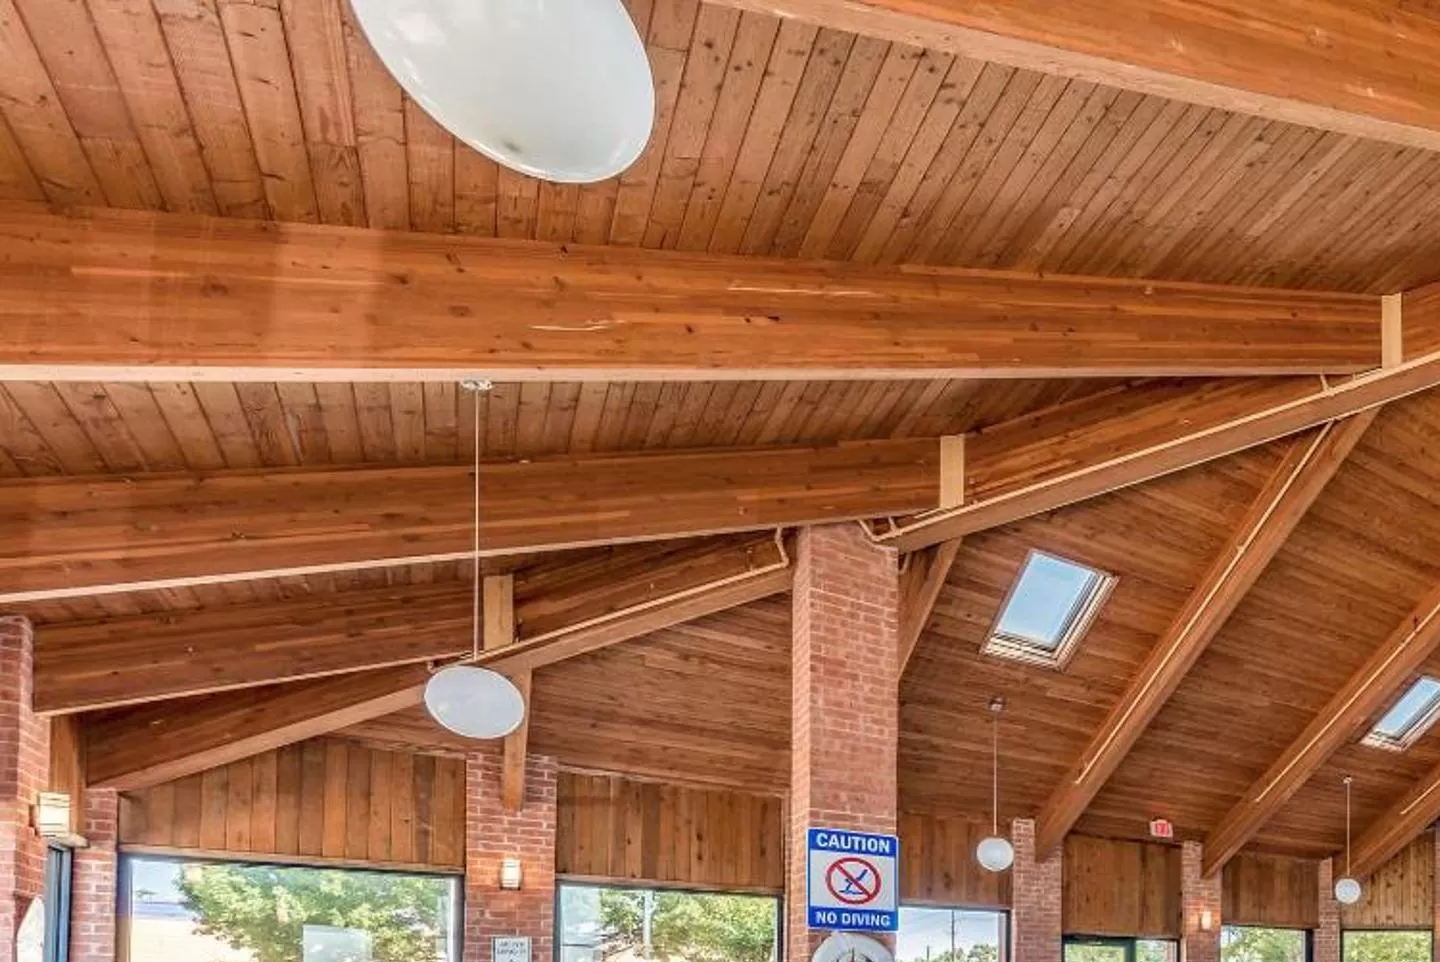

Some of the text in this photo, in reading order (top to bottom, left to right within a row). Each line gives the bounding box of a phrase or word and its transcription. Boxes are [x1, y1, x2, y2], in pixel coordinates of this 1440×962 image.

[816, 832, 890, 854] CAUTION
[815, 911, 891, 927] NO DIVING
